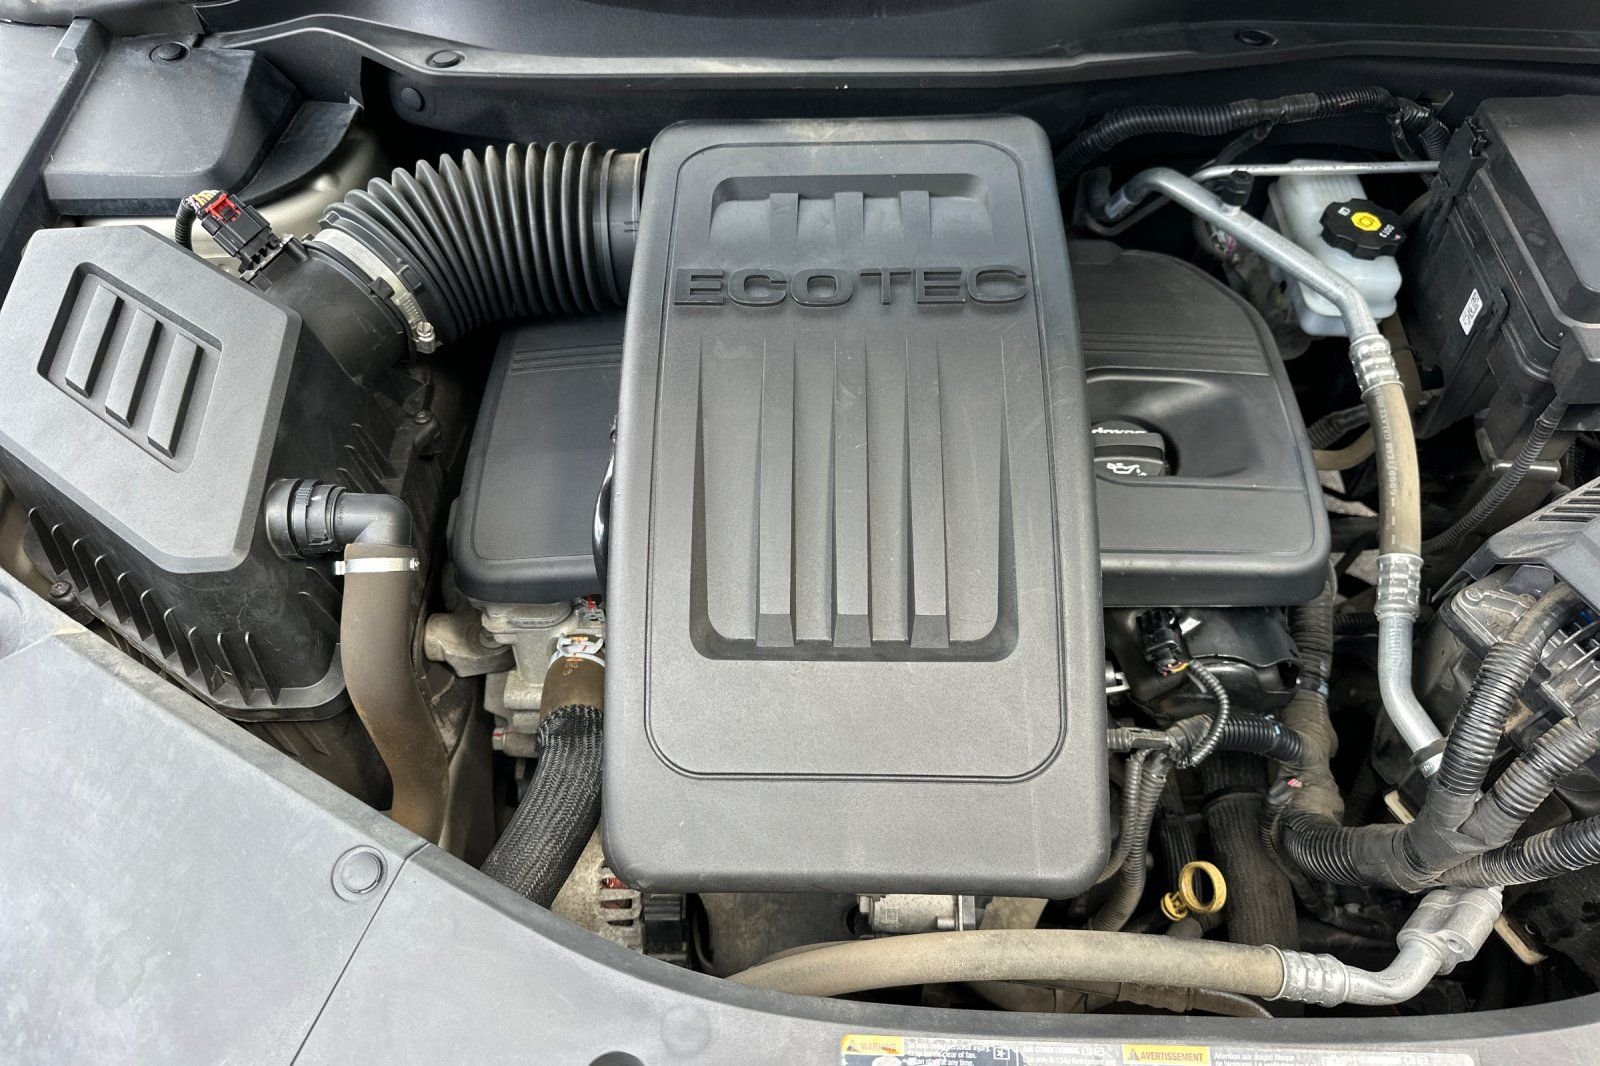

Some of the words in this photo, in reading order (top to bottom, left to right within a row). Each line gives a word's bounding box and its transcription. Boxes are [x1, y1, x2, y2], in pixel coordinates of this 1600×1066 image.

[674, 265, 1027, 306] ECOTEC
[1385, 442, 1398, 496] GOODYEAR
[1140, 1052, 1204, 1063] AVERTISSEMENT
